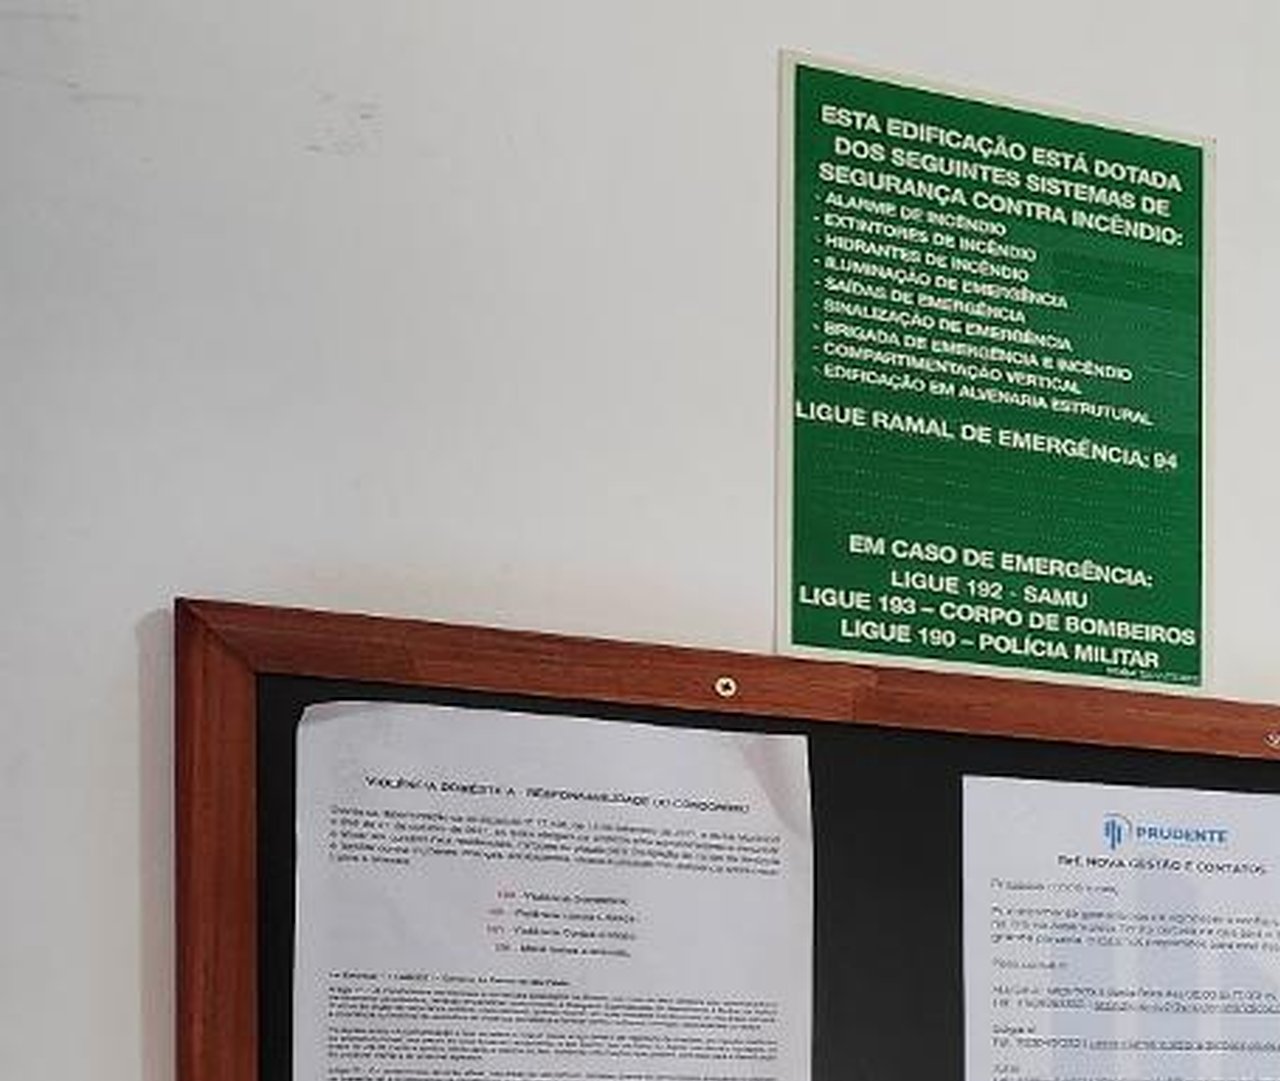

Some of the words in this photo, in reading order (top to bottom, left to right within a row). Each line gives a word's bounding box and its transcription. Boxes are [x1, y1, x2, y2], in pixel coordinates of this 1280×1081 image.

[821, 104, 881, 134] ESTA
[886, 120, 1027, 162] EDIFICAÇÃO
[1032, 142, 1091, 175] ESTÁ
[1094, 160, 1183, 192] DOTADA
[834, 136, 885, 161] DOS
[891, 145, 1020, 187] SEGUINTES
[1026, 172, 1135, 209] SISTEMAS
[1141, 195, 1171, 217] DE
[818, 163, 967, 209] SEGURANÇA
[972, 189, 1067, 226] CONTRA
[1072, 202, 1184, 247] INCÊNDIO:
[826, 191, 896, 218] ALARME
[900, 204, 923, 223] DE
[928, 206, 1007, 238] INCÊNDIO
[824, 213, 928, 244] EXTINTORES
[932, 231, 955, 249] DE
[959, 234, 1037, 263] INCÊNDIO
[825, 235, 922, 265] HIDRANTES
[926, 251, 947, 269] DE
[951, 253, 1029, 283] INCÊNDIO
[824, 255, 931, 288] ILUMINAÇÃO
[935, 273, 958, 292] DE
[962, 276, 1068, 308] EMERGÊNCIA
[824, 274, 888, 301] SAÍDAS
[891, 286, 914, 305] DE
[918, 289, 1025, 323] EMERGÊNCIA
[824, 298, 935, 332] SINALIZAÇÃO
[939, 316, 961, 334] DE
[965, 319, 1072, 352] EMERGÊNCIA
[824, 320, 900, 348] BRIGADA
[904, 332, 927, 350] DE
[931, 335, 1038, 368] EMERGÊNCIA
[1057, 353, 1132, 382] INCÊNDIO
[824, 342, 1002, 383] COMPARTIMENTAÇÃO
[1006, 367, 1082, 394] VERTICAL
[824, 363, 925, 394] EDIFICAÇÃO
[929, 379, 955, 397] EM
[959, 383, 1048, 411] ALVENARIA
[1051, 396, 1154, 427] ESTRUTURAL
[795, 399, 867, 428] LIGUE
[872, 411, 955, 439] RAMAL
[961, 423, 993, 444] DE
[999, 430, 1150, 469] EMERGÊNCIA:
[1154, 450, 1178, 470] 94
[849, 533, 885, 556] EM
[891, 539, 958, 565] CASO
[962, 548, 995, 570] DE
[1000, 552, 1153, 589] EMERGÊNCIA:
[799, 585, 872, 612] LIGUE
[879, 594, 916, 616] 193
[940, 600, 1022, 627] CORPO
[1029, 609, 1060, 631] DE
[1065, 613, 1196, 646] BOMBEIROS
[891, 569, 959, 596] LIGUE
[967, 578, 1002, 600] 192
[1023, 585, 1089, 609] SAMU
[840, 618, 912, 645] LIGUE
[919, 627, 956, 649] 190
[979, 630, 1068, 660] POLÍCIA
[1073, 642, 1160, 670] MILITAR
[1136, 827, 1229, 843] PRUDENTE
[1086, 857, 1127, 869] NOVA
